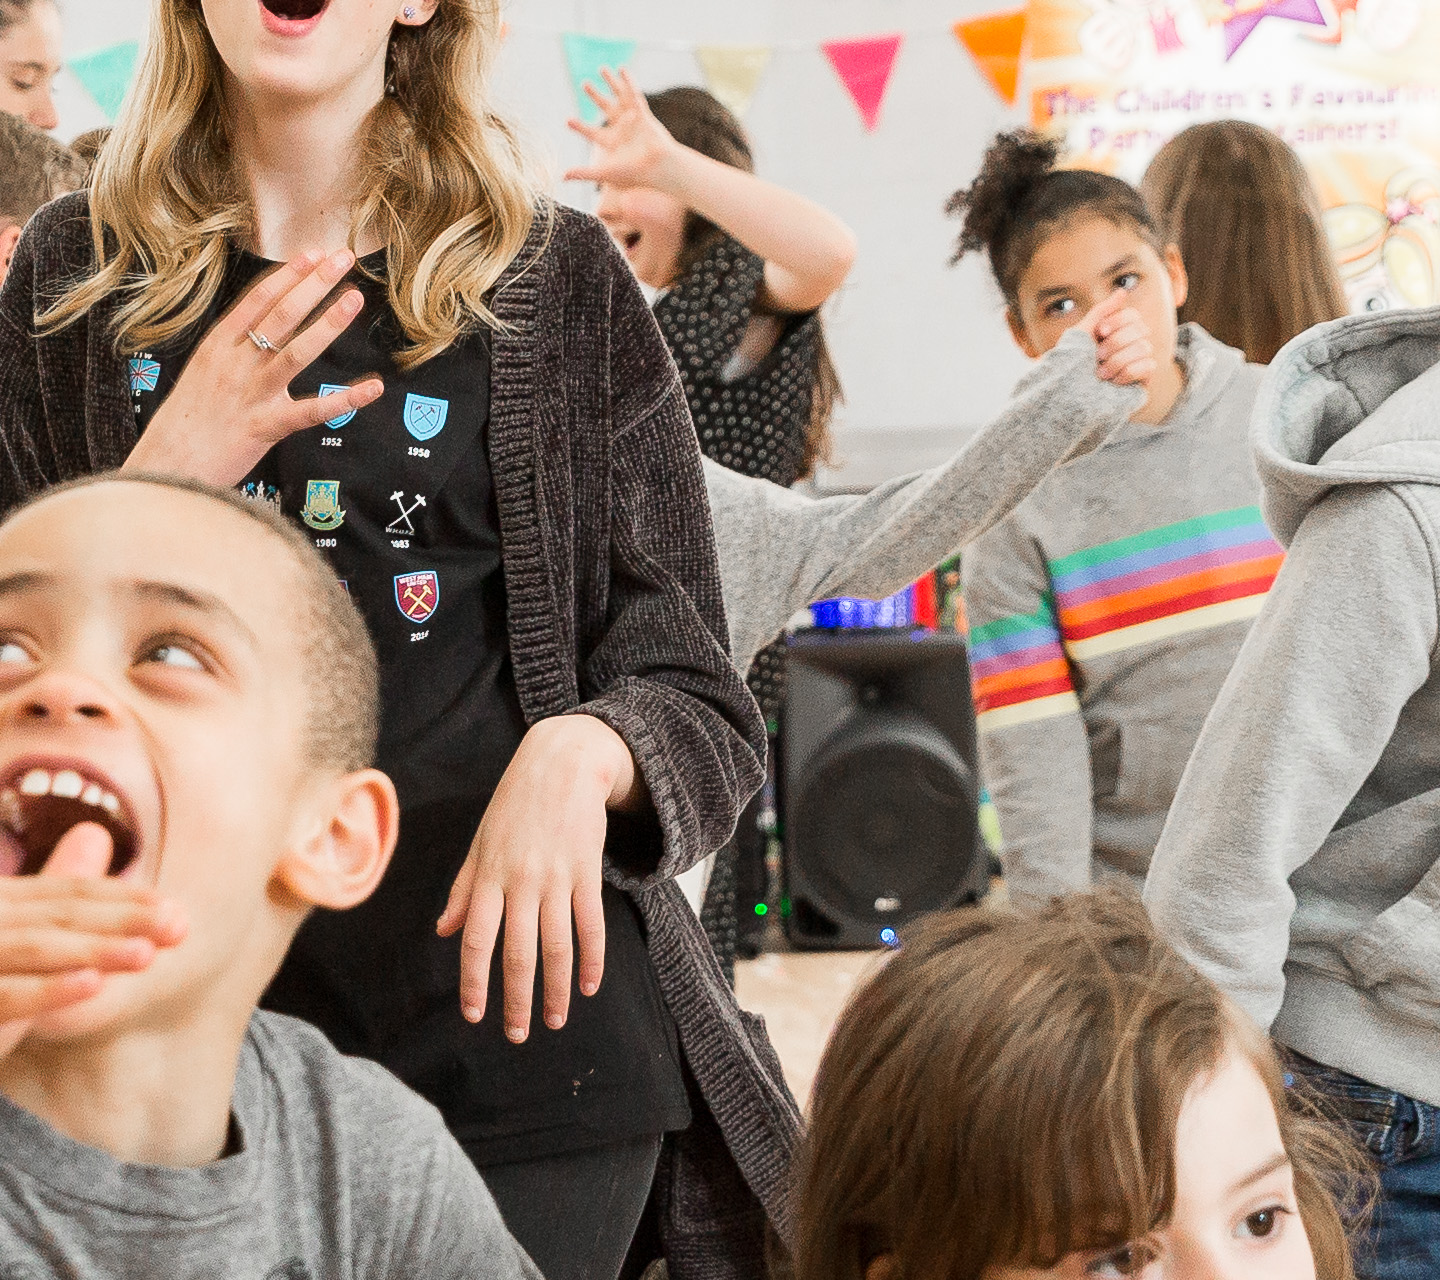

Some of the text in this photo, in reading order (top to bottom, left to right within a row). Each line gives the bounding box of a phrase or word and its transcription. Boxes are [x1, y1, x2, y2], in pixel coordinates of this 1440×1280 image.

[1045, 88, 1098, 117] The
[321, 437, 343, 448] 1952
[315, 538, 337, 548] 1980
